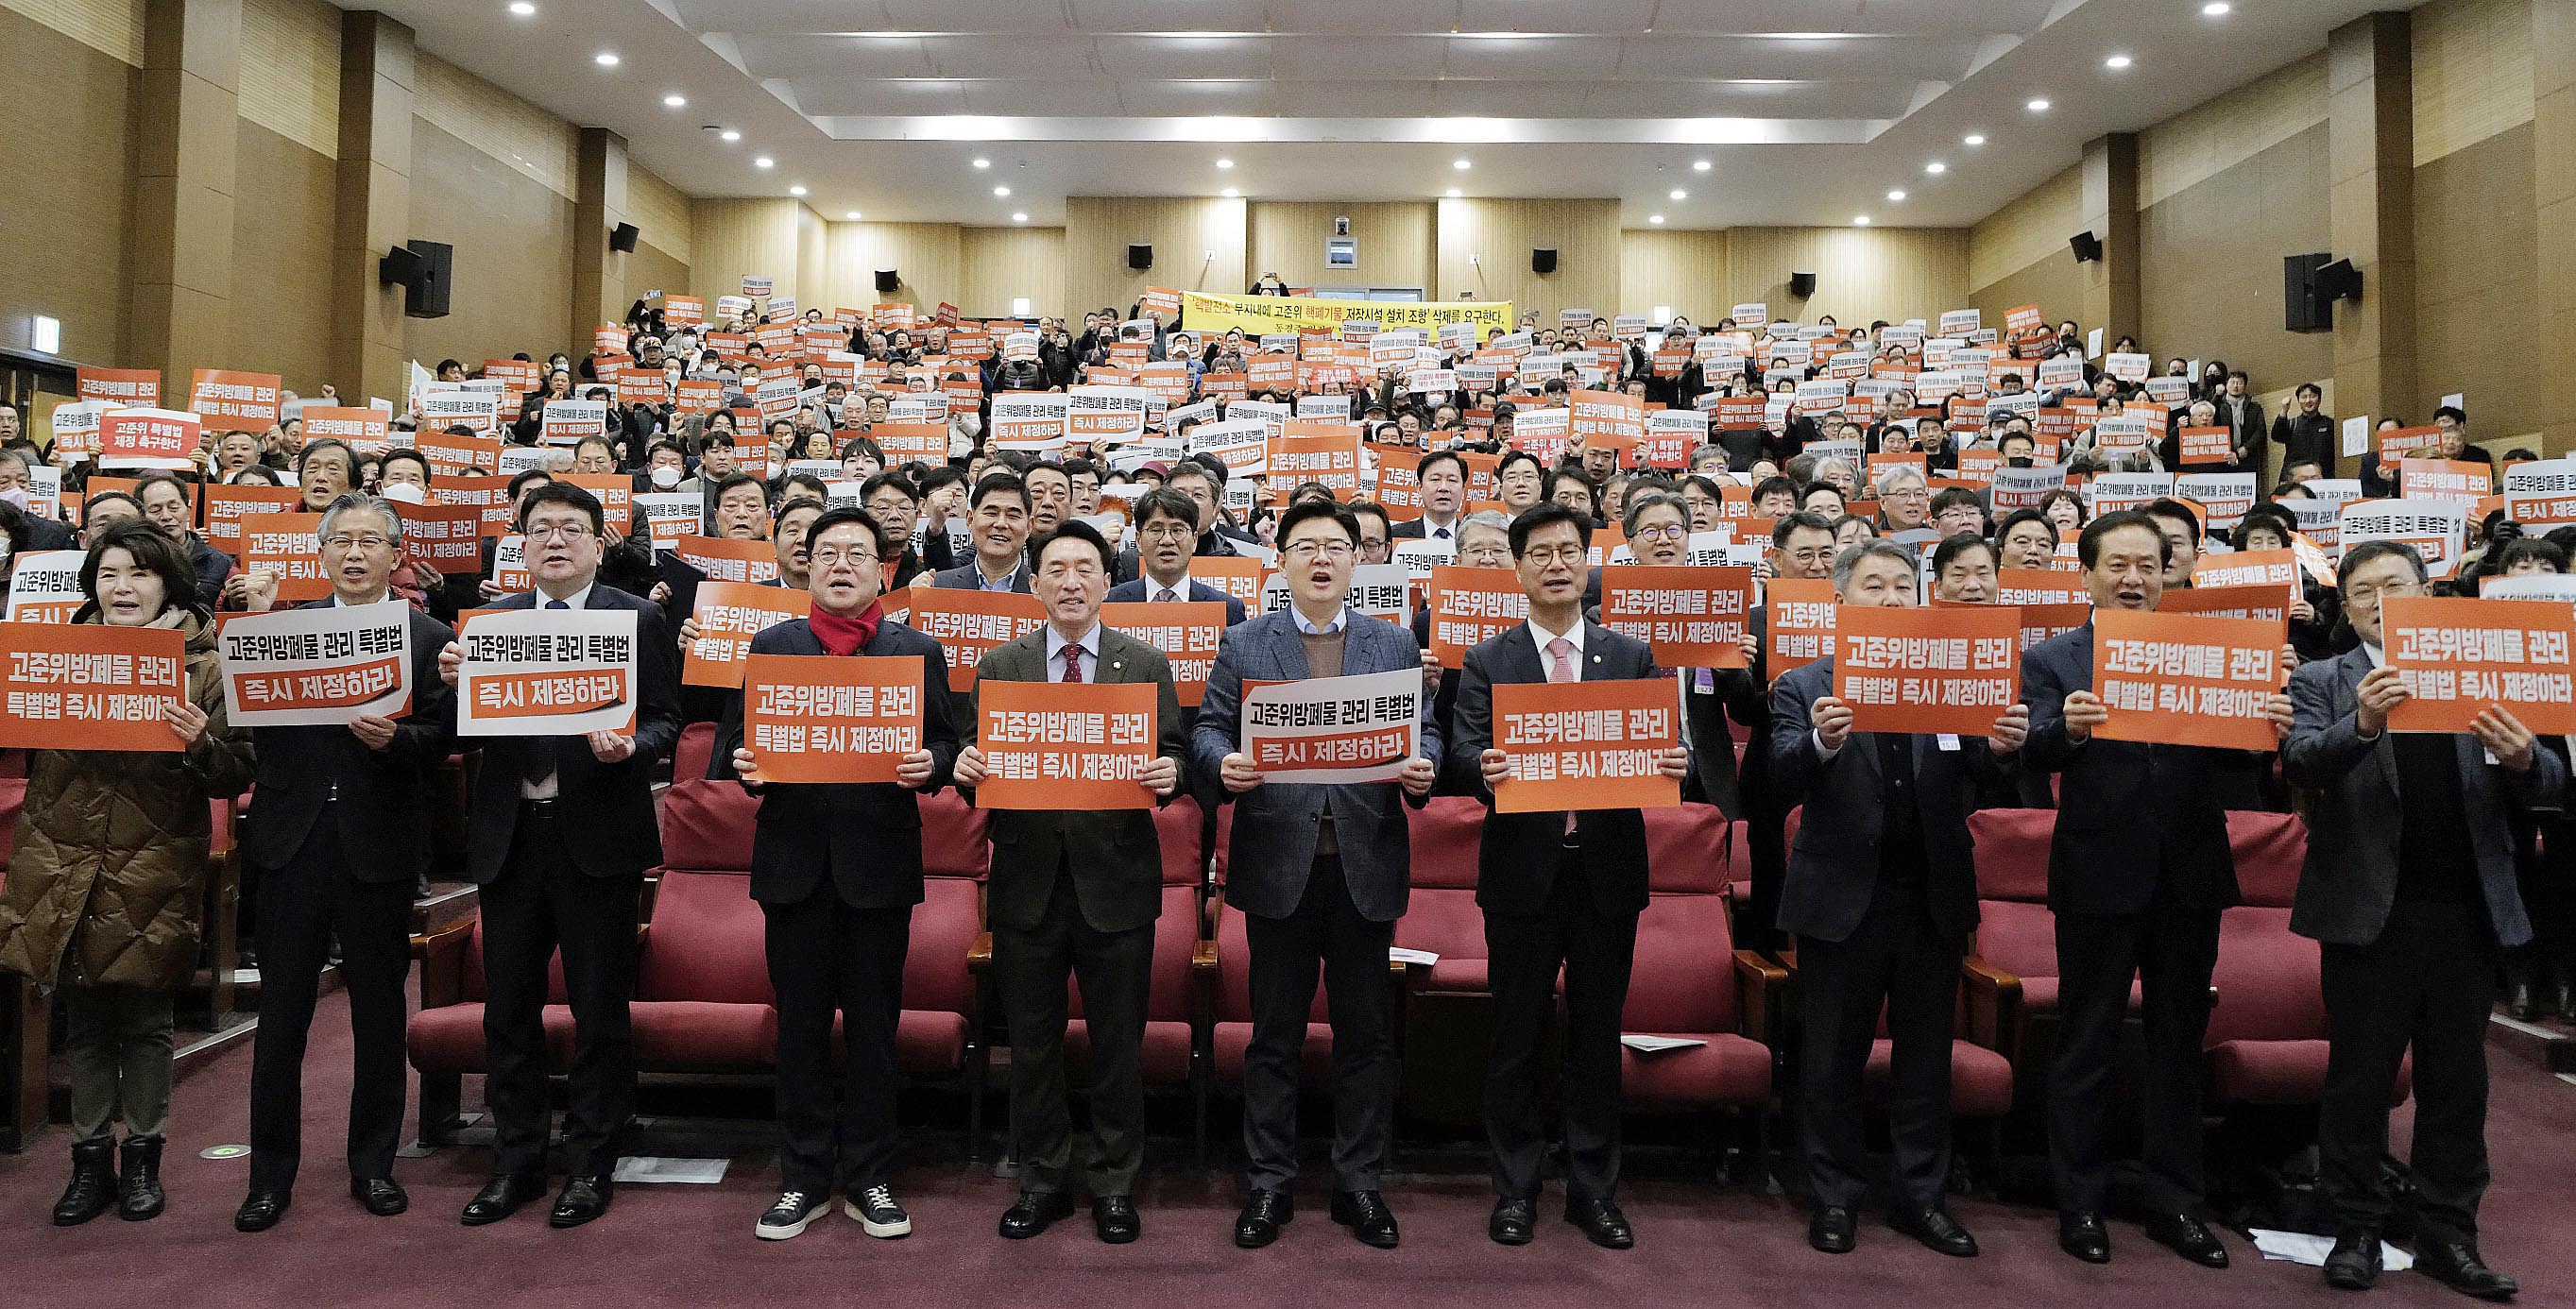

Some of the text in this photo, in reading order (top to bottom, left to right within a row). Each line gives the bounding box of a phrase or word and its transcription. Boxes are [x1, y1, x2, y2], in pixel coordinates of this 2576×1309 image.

[1235, 304, 1271, 317] 부지내에
[1274, 306, 1302, 319] 고준위
[1306, 307, 1342, 321] 핵폐기물
[1346, 308, 1383, 320] 저장시설
[1387, 310, 1405, 323] 설치
[1433, 310, 1460, 323] 삭제를
[139, 382, 156, 397] 관리
[196, 382, 275, 402] 고준위방폐물 관리
[221, 402, 237, 416] 즉시
[463, 400, 474, 413] 관리
[476, 401, 493, 414] 특별법
[995, 405, 1066, 417] 고준위방폐물 관리 특별법
[1069, 396, 1142, 411] 고준위방폐물 관리 특별법
[1575, 402, 1641, 422] 고준위방폐물 관리
[577, 408, 588, 418] 관리
[115, 422, 182, 436] 고준위 특별법
[365, 421, 384, 437] 관리
[550, 425, 564, 434] 즉시
[998, 422, 1061, 437] 즉시 제정하라
[1074, 416, 1136, 430] 즉시 제정하라
[1598, 423, 1612, 435] 즉시
[114, 436, 182, 450] 제정 촉구한다
[876, 436, 943, 450] 고준위방폐물 관리
[1231, 433, 1244, 445] 관리
[1246, 429, 1264, 443] 특별법
[1523, 440, 1545, 450] 고준위
[475, 451, 494, 466] 관리
[751, 447, 765, 457] 관리
[1270, 450, 1353, 470] 고준위방폐물 관리
[1270, 474, 1355, 490] 특별법 제정하라
[1472, 471, 1490, 486] 관리
[2469, 477, 2487, 492] 관리
[2509, 475, 2566, 491] 고준위방폐물
[608, 489, 628, 504] 관리
[1230, 491, 1250, 504] 특별법
[1380, 489, 1408, 507] 특별법
[2137, 484, 2148, 496] 관리
[2151, 484, 2170, 495] 특별법
[2219, 484, 2231, 497] 관리
[2234, 484, 2253, 496] 특별법
[668, 503, 700, 517] 관리 특별법
[1728, 502, 1747, 517] 관리
[2207, 502, 2246, 517] 제정하라
[2516, 503, 2547, 518] 즉시
[452, 519, 476, 537] 관리
[657, 522, 695, 536] 제정하라
[410, 542, 476, 558] 즉시 제정하라
[504, 573, 530, 588] 즉시
[749, 561, 778, 582] 관리
[2270, 564, 2292, 582] 관리
[1230, 577, 1257, 598] 관리
[1368, 586, 1403, 607] 특별법
[1610, 589, 1743, 615] 고준위방폐물 관리
[919, 612, 1011, 641] 고준위방폐물
[1438, 622, 1478, 645] 특별법
[1655, 622, 1682, 643] 즉시
[1686, 622, 1743, 644] 제정하라
[227, 624, 402, 662] 고준위방폐물 관리 특별법
[468, 635, 629, 662] 고준위방폐물 관리 특별법
[1187, 627, 1220, 652] 관리
[1777, 635, 1817, 657] 특별법
[2397, 628, 2568, 665] 고준위방폐물 관리
[693, 639, 733, 661] 특별법
[1846, 636, 1968, 670] 고준위방폐물
[1973, 638, 2011, 670] 관리
[8, 652, 177, 687] 고준위방폐물 관리
[2105, 639, 2273, 682] 고준위방폐물 관리
[245, 665, 394, 703] 즉시 제정하라
[479, 676, 619, 708] 즉시 제정하라
[1845, 677, 2010, 706] 특별법 즉시 제정하라
[2399, 670, 2573, 704] 특별법 즉시 제정하라
[8, 691, 60, 719] 특별법
[65, 693, 101, 720] 즉시
[756, 685, 916, 717] 고준위방폐물 관리
[2104, 680, 2155, 711] 특별법
[2158, 684, 2193, 714] 즉시
[1251, 693, 1415, 726] 고준위방폐물 관리 특별법
[988, 711, 1149, 744] 고준위방폐물 관리
[1504, 708, 1668, 744] 고준위방폐물 관리
[756, 725, 916, 754] 특별법 즉시 제정하라
[1262, 733, 1403, 764] 즉시 제정하라
[987, 752, 1037, 779] 특별법
[1043, 753, 1076, 780] 즉시
[1561, 752, 1595, 778] 즉시
